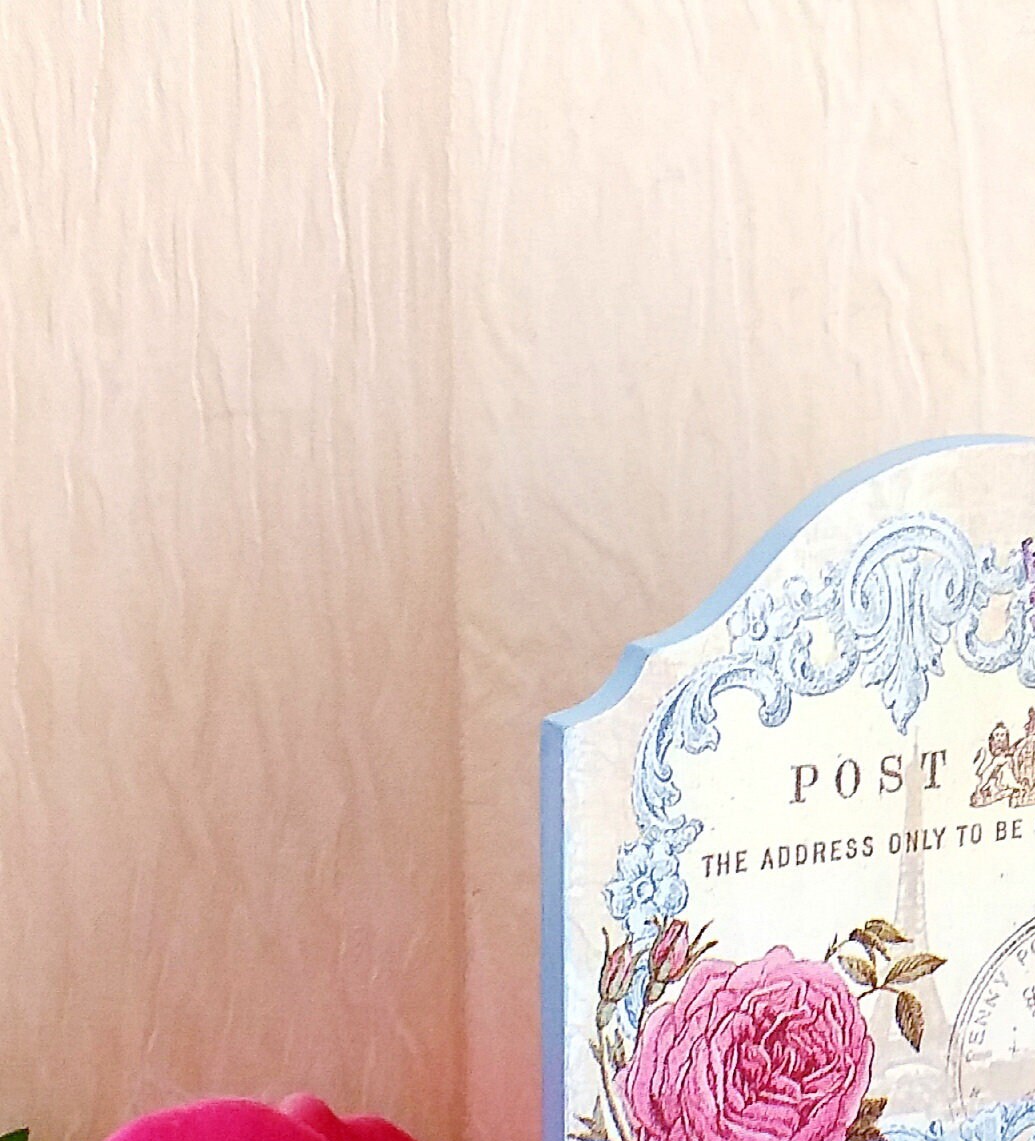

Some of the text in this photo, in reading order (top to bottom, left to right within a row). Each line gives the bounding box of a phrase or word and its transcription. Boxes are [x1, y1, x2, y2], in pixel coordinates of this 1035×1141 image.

[789, 749, 947, 804] POST
[701, 851, 748, 878] THE
[760, 835, 875, 872] ADDRESS
[888, 825, 945, 855] ONLY
[956, 823, 983, 847] TO
[996, 817, 1024, 842] BE
